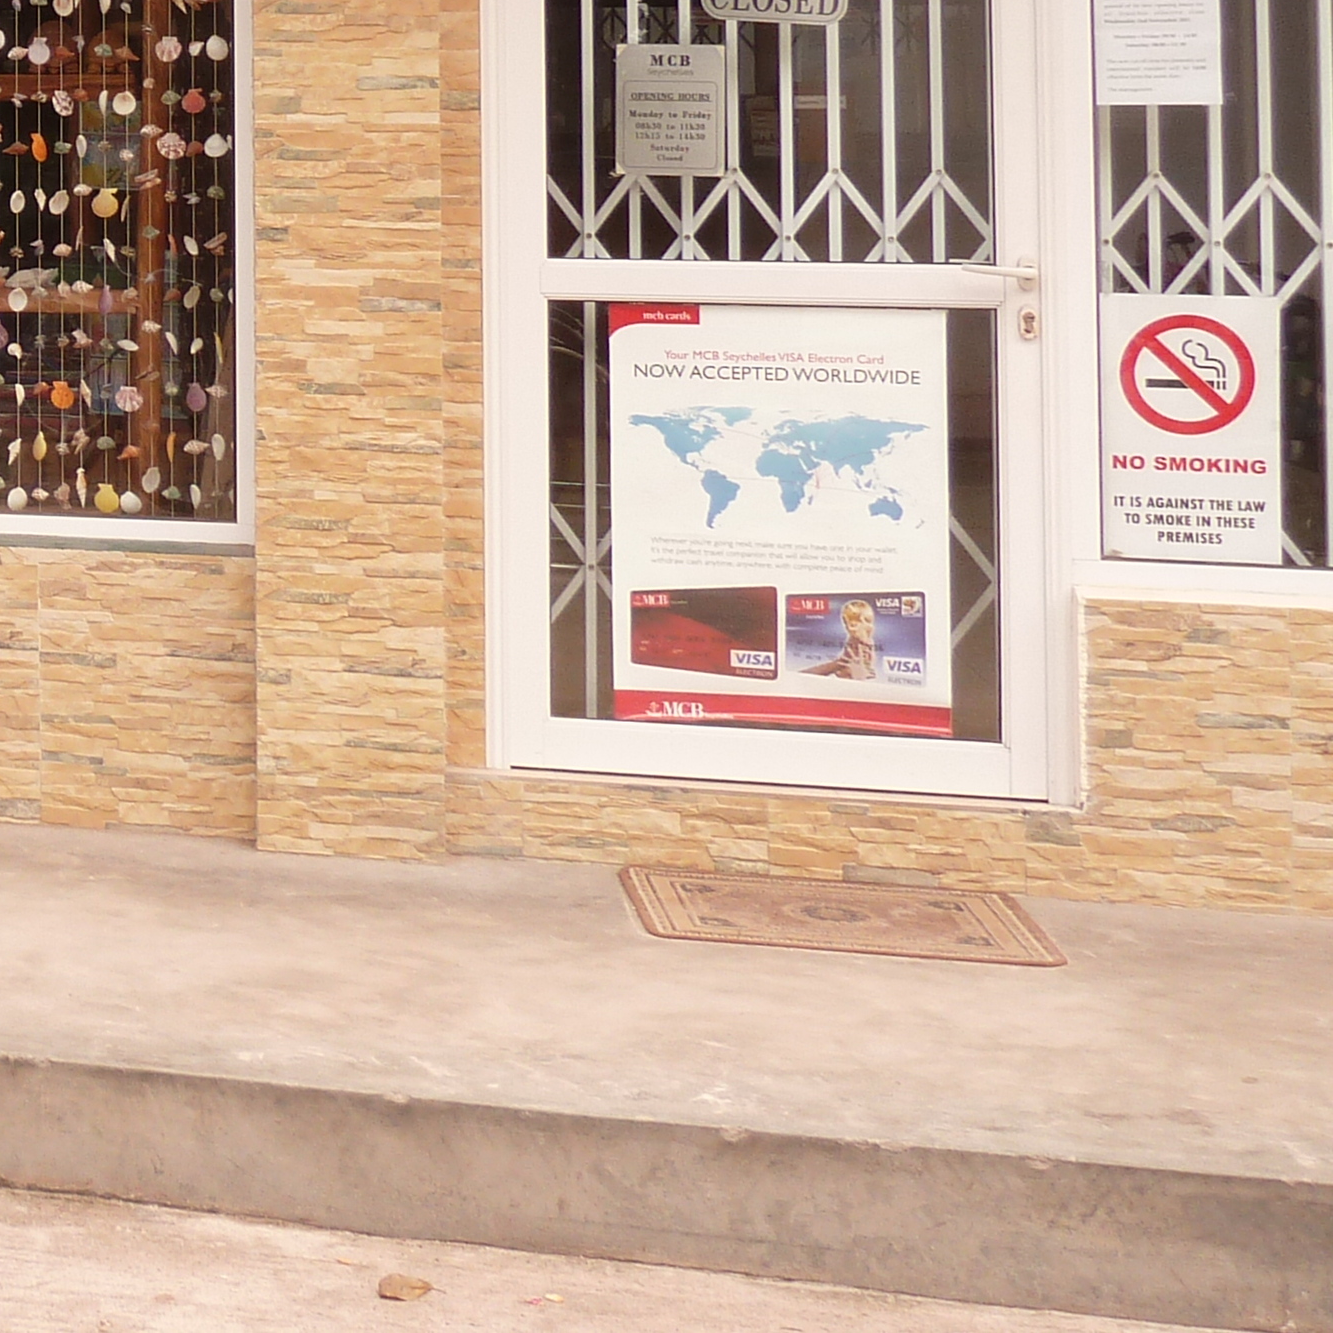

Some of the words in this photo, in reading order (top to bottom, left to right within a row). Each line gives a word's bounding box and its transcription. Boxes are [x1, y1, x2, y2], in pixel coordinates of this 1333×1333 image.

[650, 54, 691, 66] MCB
[630, 93, 674, 101] OPENING
[678, 93, 710, 101] HOURS
[629, 110, 664, 119] Monday
[682, 111, 712, 121] Friday
[665, 311, 691, 320] cards
[664, 350, 689, 360] Your
[692, 351, 720, 361] MCB
[722, 351, 776, 363] Seychelles
[777, 352, 805, 363] VISA
[808, 353, 853, 364] Electron
[857, 354, 884, 365] Card
[633, 363, 686, 378] NOW
[689, 365, 789, 381] ACCEPTED
[792, 368, 921, 385] WORLDWIDE
[1112, 455, 1145, 469] NO
[1153, 456, 1267, 474] SMOKING
[1113, 496, 1125, 507] IT
[1130, 496, 1142, 508] IS
[1146, 497, 1204, 510] AGAINST
[1208, 499, 1233, 511] THE
[1236, 501, 1266, 513] LAW
[1124, 513, 1140, 524] TO
[1145, 514, 1192, 527] SMOKE
[1196, 515, 1211, 527] IN
[1216, 516, 1256, 529] THESE
[1157, 531, 1223, 544] PREMISES
[642, 595, 668, 606] MCB
[800, 599, 825, 611] MCB
[875, 598, 900, 609] VISA
[735, 652, 774, 667] VISA
[887, 659, 922, 674] VISA
[661, 701, 704, 717] MCB
